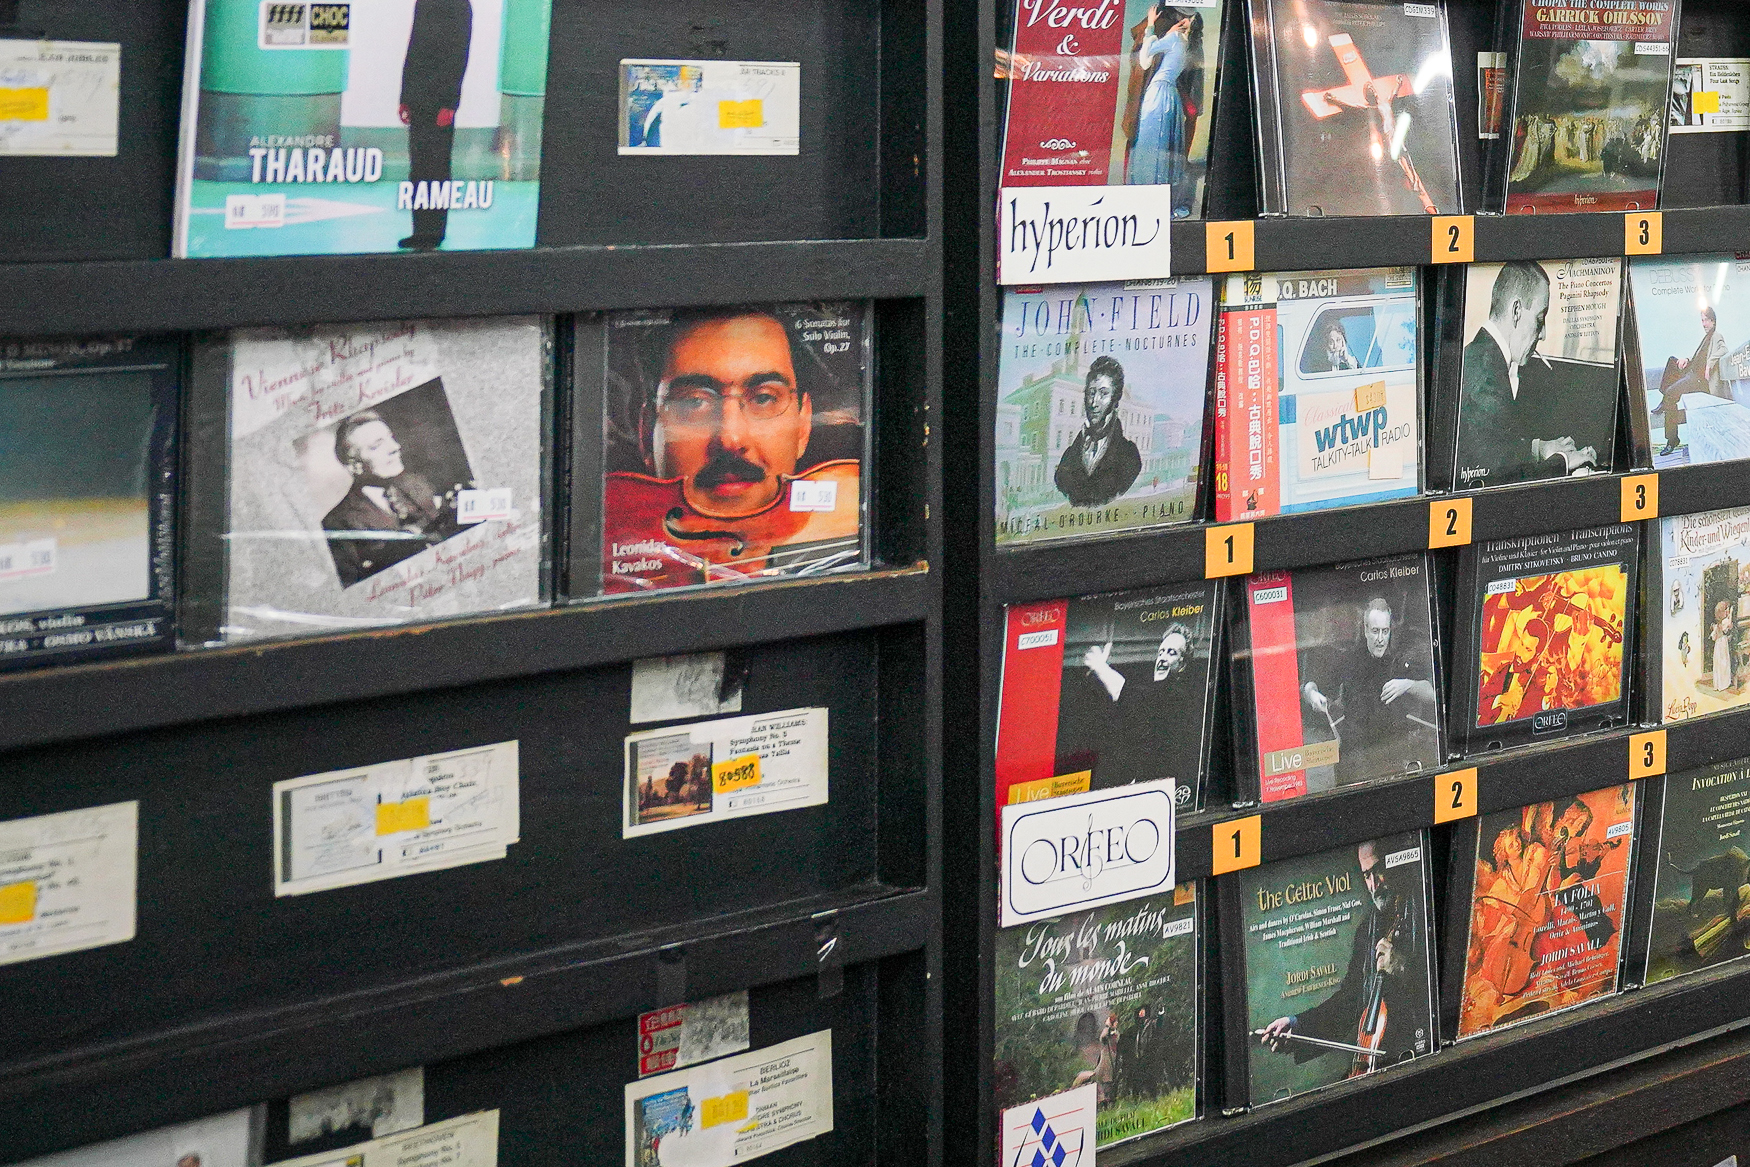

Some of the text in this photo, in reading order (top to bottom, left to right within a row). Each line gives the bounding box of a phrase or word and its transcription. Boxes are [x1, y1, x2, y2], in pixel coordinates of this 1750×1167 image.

[310, 5, 350, 28] CHOC
[1536, 9, 1664, 26] GARRICK OHLSSON
[1569, 0, 1588, 9] THE
[1589, 0, 1637, 10] COMPLETE
[1639, 1, 1669, 11] WORKS
[1056, 32, 1081, 56] &
[1020, 60, 1110, 85] Variations
[249, 148, 383, 182] THARAUD
[398, 181, 494, 210] RAMEAU
[1010, 196, 1160, 273] hyperion
[1447, 226, 1459, 253] 2
[1639, 220, 1649, 245] 3
[1224, 231, 1235, 260] 1
[1302, 279, 1338, 297] BACH
[1558, 281, 1584, 290] The Piano
[1582, 289, 1610, 300] Rhapsody
[1014, 344, 1037, 360] THE
[1314, 406, 1388, 454] wtwp
[1311, 422, 1411, 472] TALKITY-TALK RADIO
[1460, 465, 1490, 480] hyperion
[1636, 484, 1646, 510] 3
[1142, 501, 1184, 520] PIANO
[1446, 508, 1457, 535] 2
[1225, 536, 1234, 563] 1
[1570, 549, 1618, 563] BRUNO CANINO
[612, 558, 663, 574] Kavakos
[1360, 565, 1420, 582] Carlos Kleiber
[1140, 603, 1204, 623] Carlos Kleiber
[1271, 750, 1303, 773] Live
[1643, 741, 1654, 767] 3
[1692, 772, 1738, 791] INVOCATION
[1452, 782, 1463, 809] 2
[1021, 816, 1160, 887] ORFEO
[1231, 830, 1241, 857] 1
[1387, 850, 1419, 866] AVSA9865
[1285, 871, 1351, 905] Celtic Viol
[1103, 902, 1167, 943] matins
[1039, 940, 1150, 995] du monde
[1540, 949, 1567, 966] JORDI
[1286, 963, 1338, 985] JORDI SAVALL
